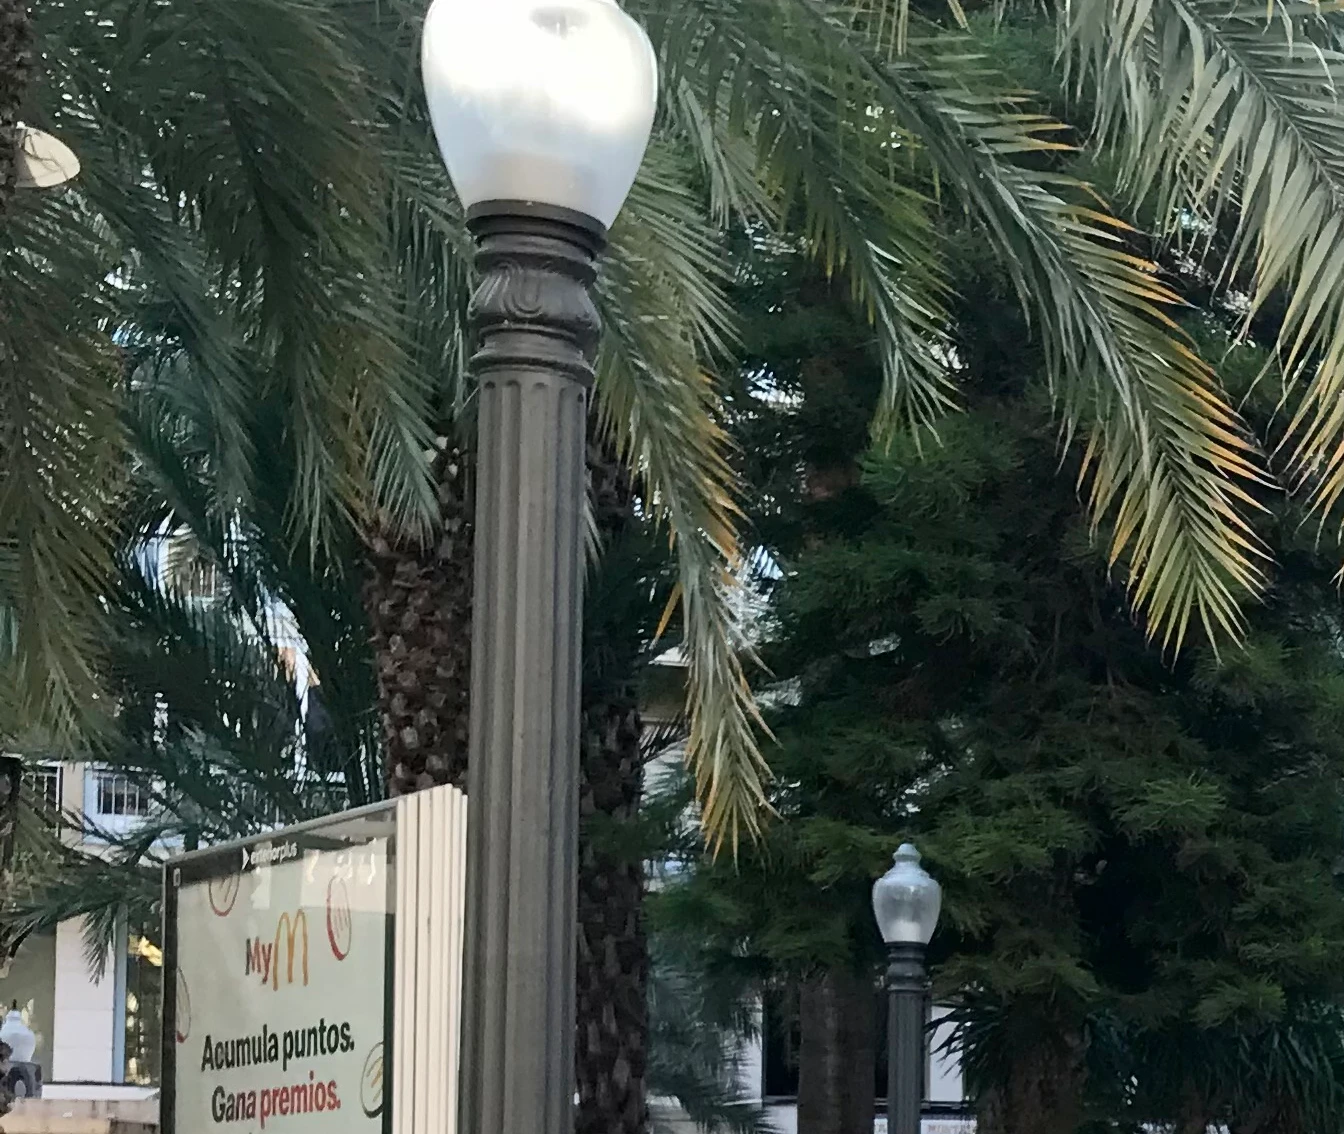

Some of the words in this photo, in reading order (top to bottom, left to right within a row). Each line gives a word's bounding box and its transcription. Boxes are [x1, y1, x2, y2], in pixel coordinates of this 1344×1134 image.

[201, 1023, 279, 1072] Acumula
[282, 1017, 355, 1072] puntos.
[211, 1085, 257, 1123] Gana
[260, 1069, 341, 1129] premios.
